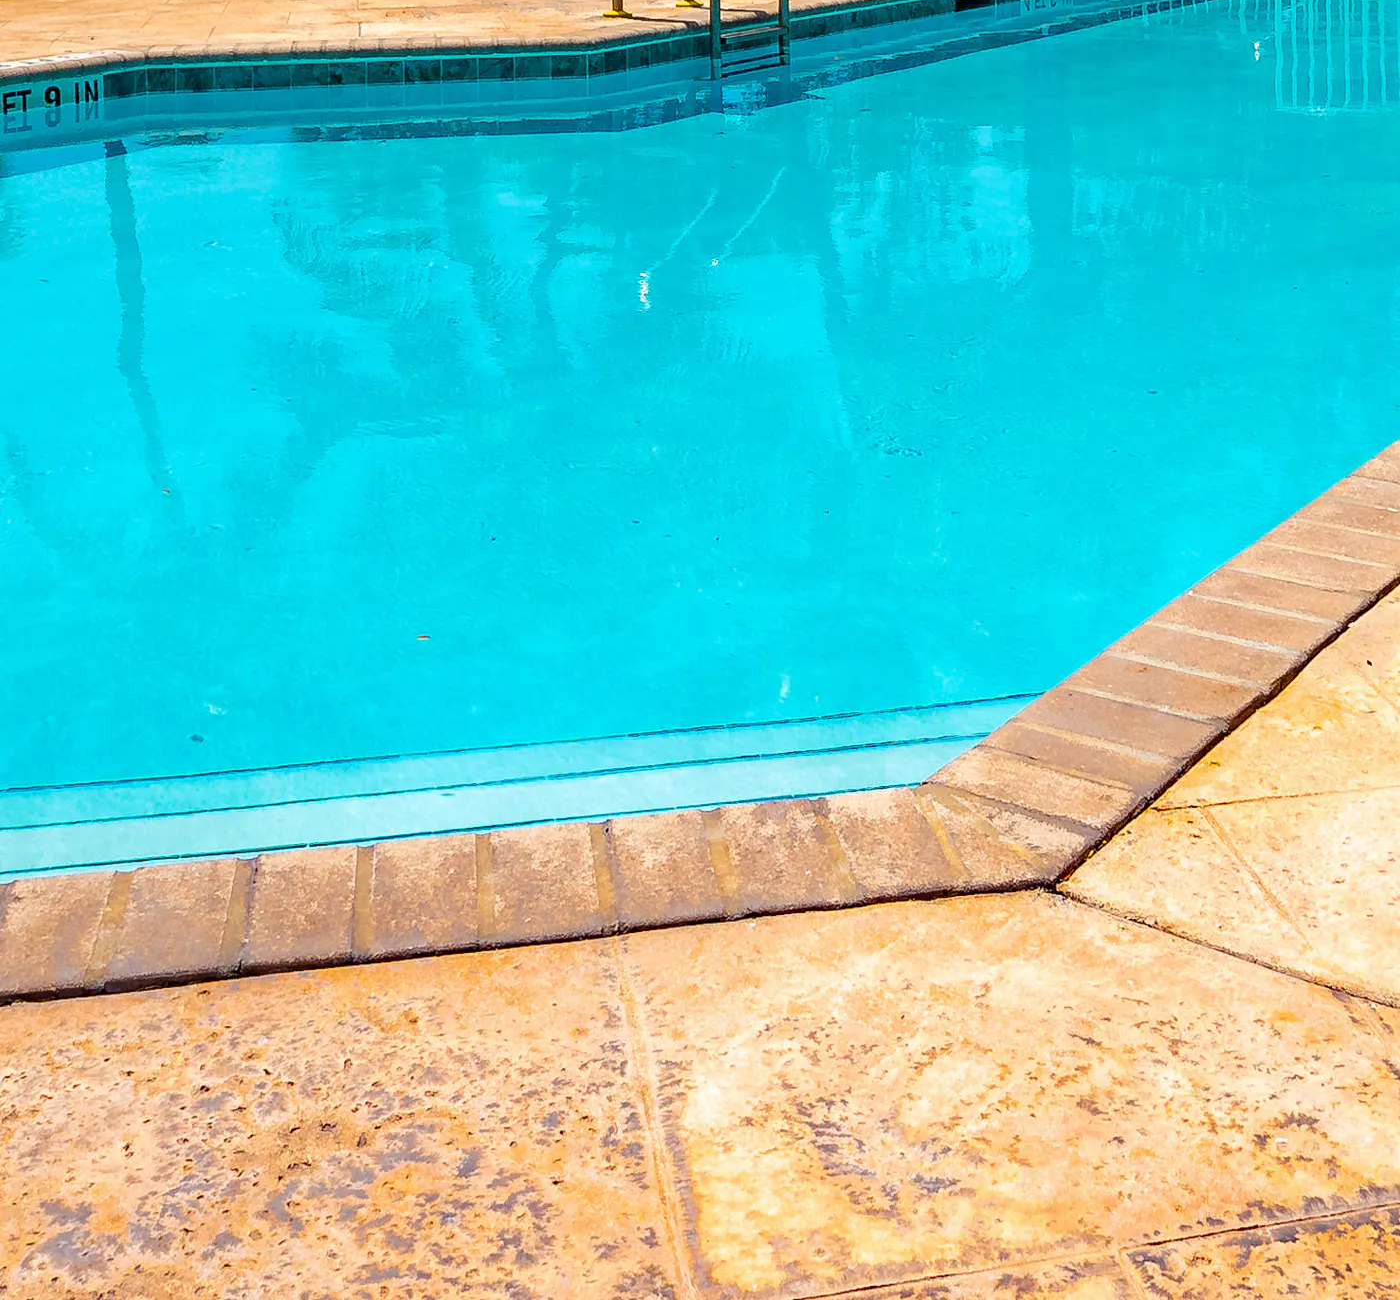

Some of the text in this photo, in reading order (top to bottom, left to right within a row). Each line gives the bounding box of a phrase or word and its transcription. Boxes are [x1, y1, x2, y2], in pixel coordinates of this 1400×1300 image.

[2, 80, 99, 114] FT 9 IN
